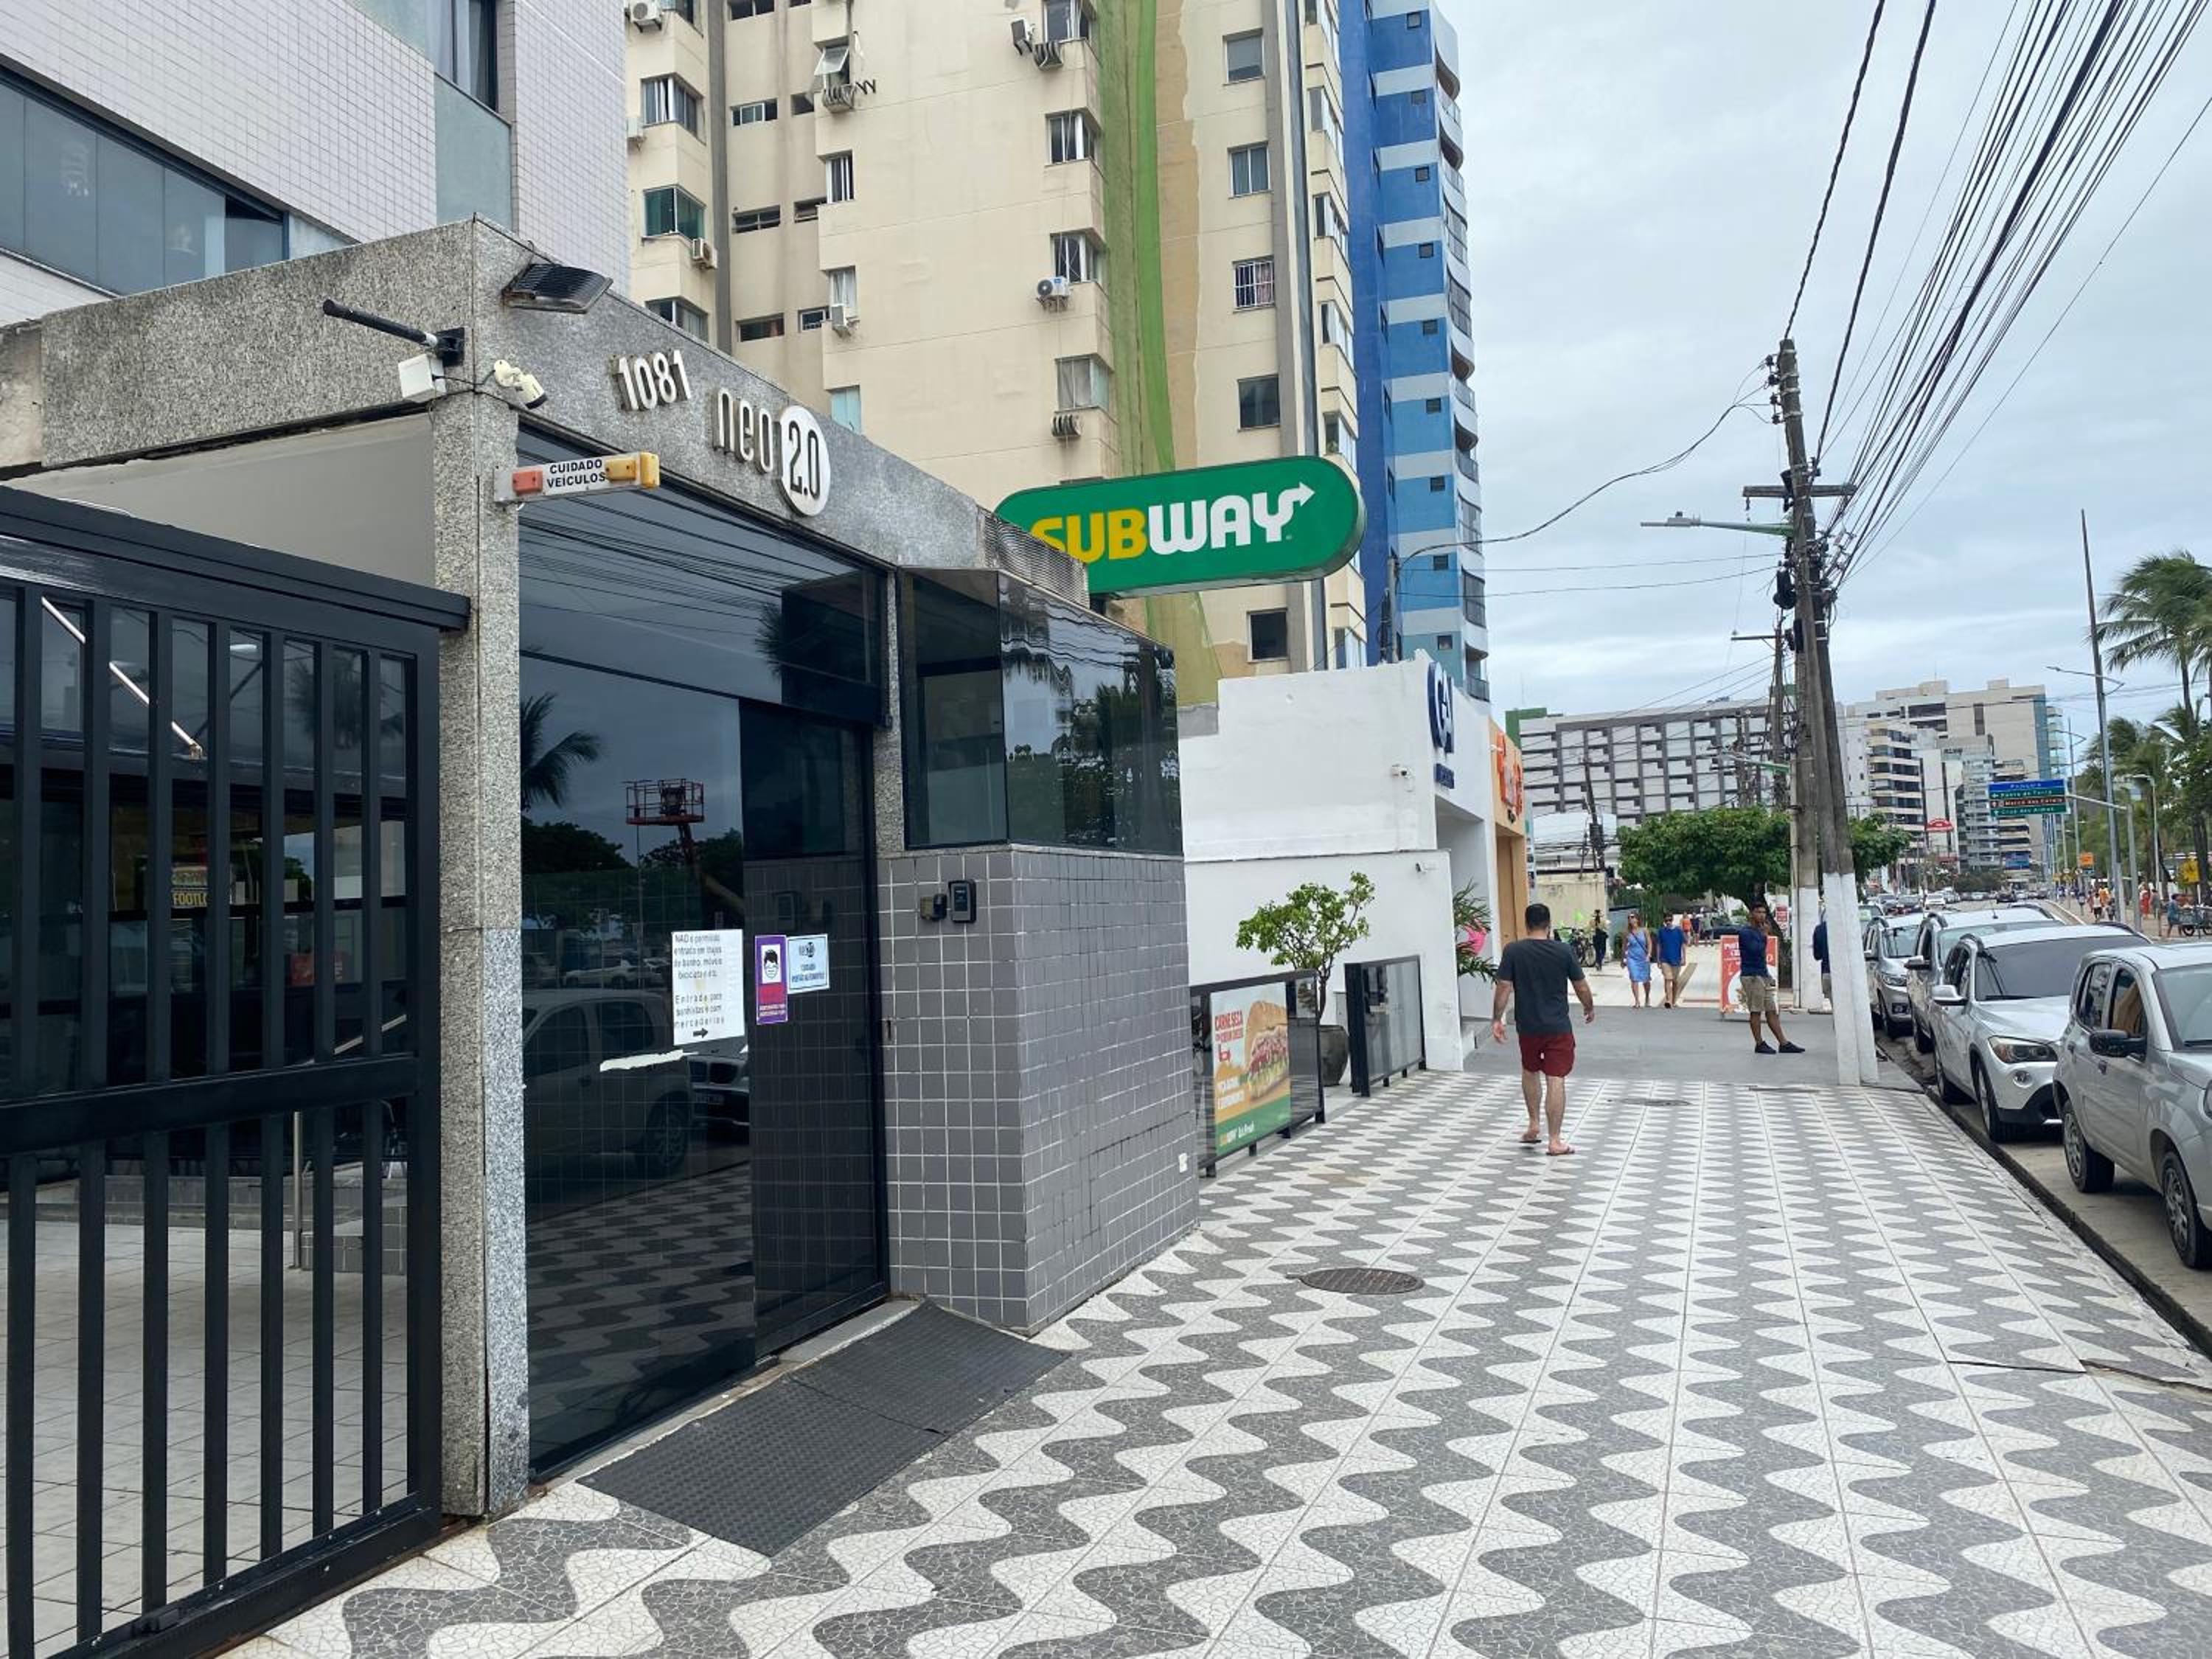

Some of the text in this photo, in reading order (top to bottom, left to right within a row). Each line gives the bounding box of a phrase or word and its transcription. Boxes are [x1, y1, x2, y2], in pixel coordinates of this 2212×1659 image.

[617, 349, 692, 411] 1081
[549, 459, 602, 474] CUIDADO
[717, 388, 821, 501] neo 2.0
[546, 471, 606, 489] VEÍCULOS
[1032, 481, 1315, 564] SUBWAY
